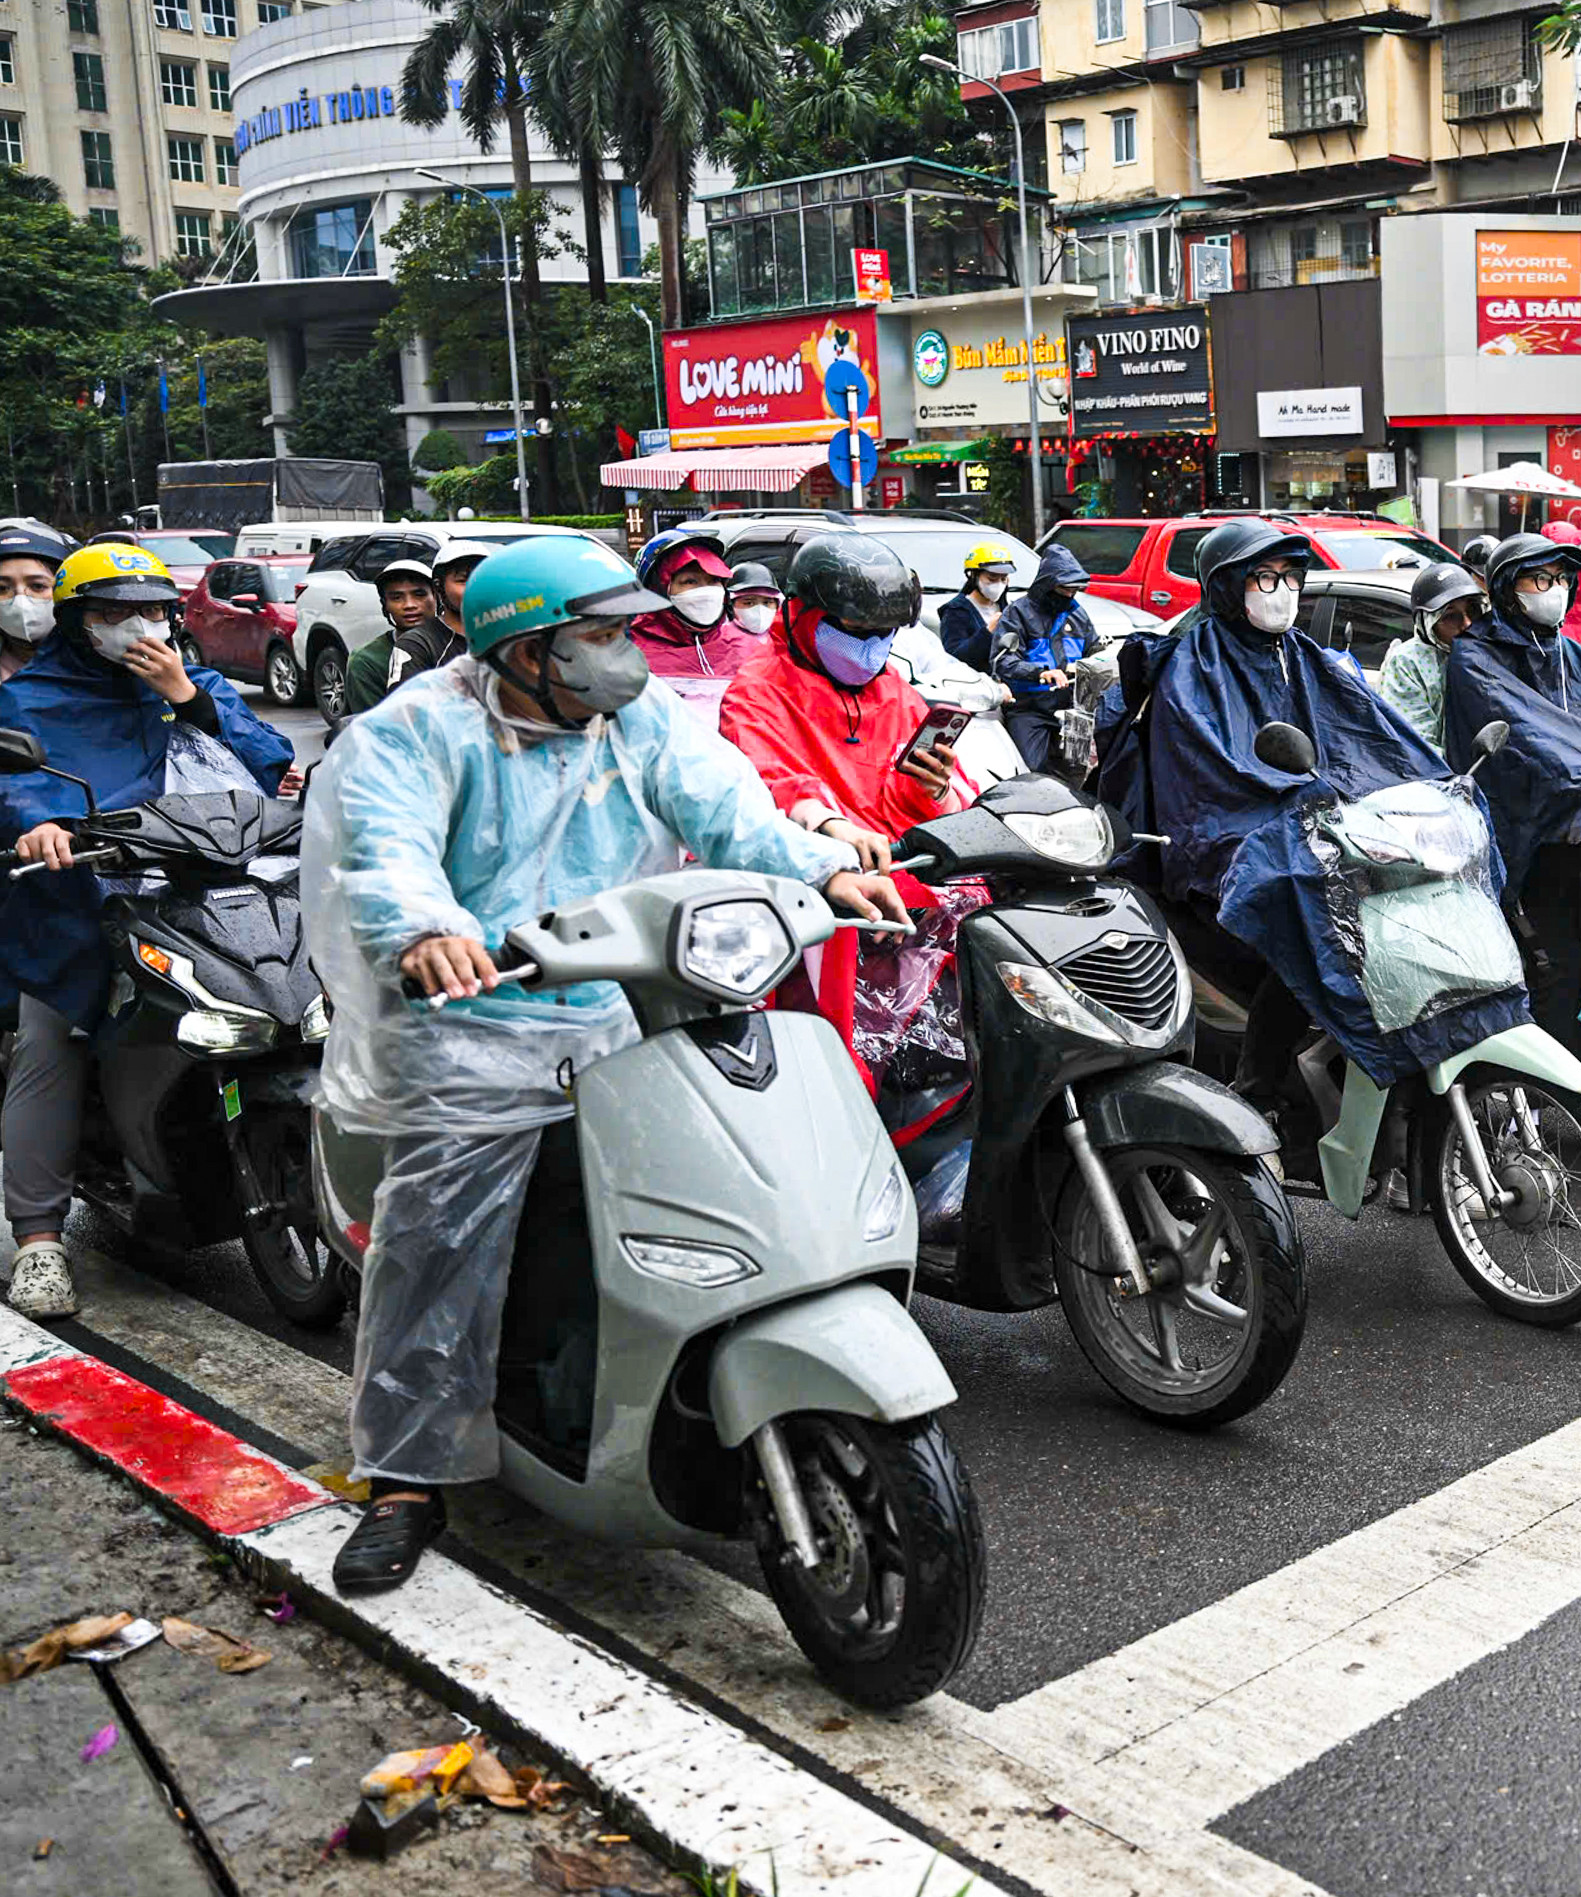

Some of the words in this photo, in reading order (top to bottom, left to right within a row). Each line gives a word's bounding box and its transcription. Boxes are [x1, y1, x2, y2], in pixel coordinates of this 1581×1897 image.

[281, 87, 322, 134] VIỄN
[324, 83, 394, 124] THÔNG
[1480, 241, 1507, 254] My
[1480, 257, 1572, 269] FAVORITE,
[1480, 272, 1567, 283] LOTTERIA
[1485, 299, 1523, 318] GÀ
[1096, 330, 1147, 356] VINO
[1150, 325, 1200, 352] FINO
[952, 344, 982, 370] Bún
[984, 336, 1019, 367] Mắm
[1121, 361, 1149, 376] World
[1150, 361, 1160, 373] of
[1161, 359, 1188, 373] Wine
[679, 356, 740, 405] LOVE
[1075, 398, 1095, 412] NHẬP
[1184, 391, 1207, 404] VANG
[1291, 404, 1303, 414] Ma
[1307, 404, 1327, 414] Hand
[1331, 403, 1351, 413] made
[110, 551, 151, 571] be
[211, 888, 258, 900] HONDA
